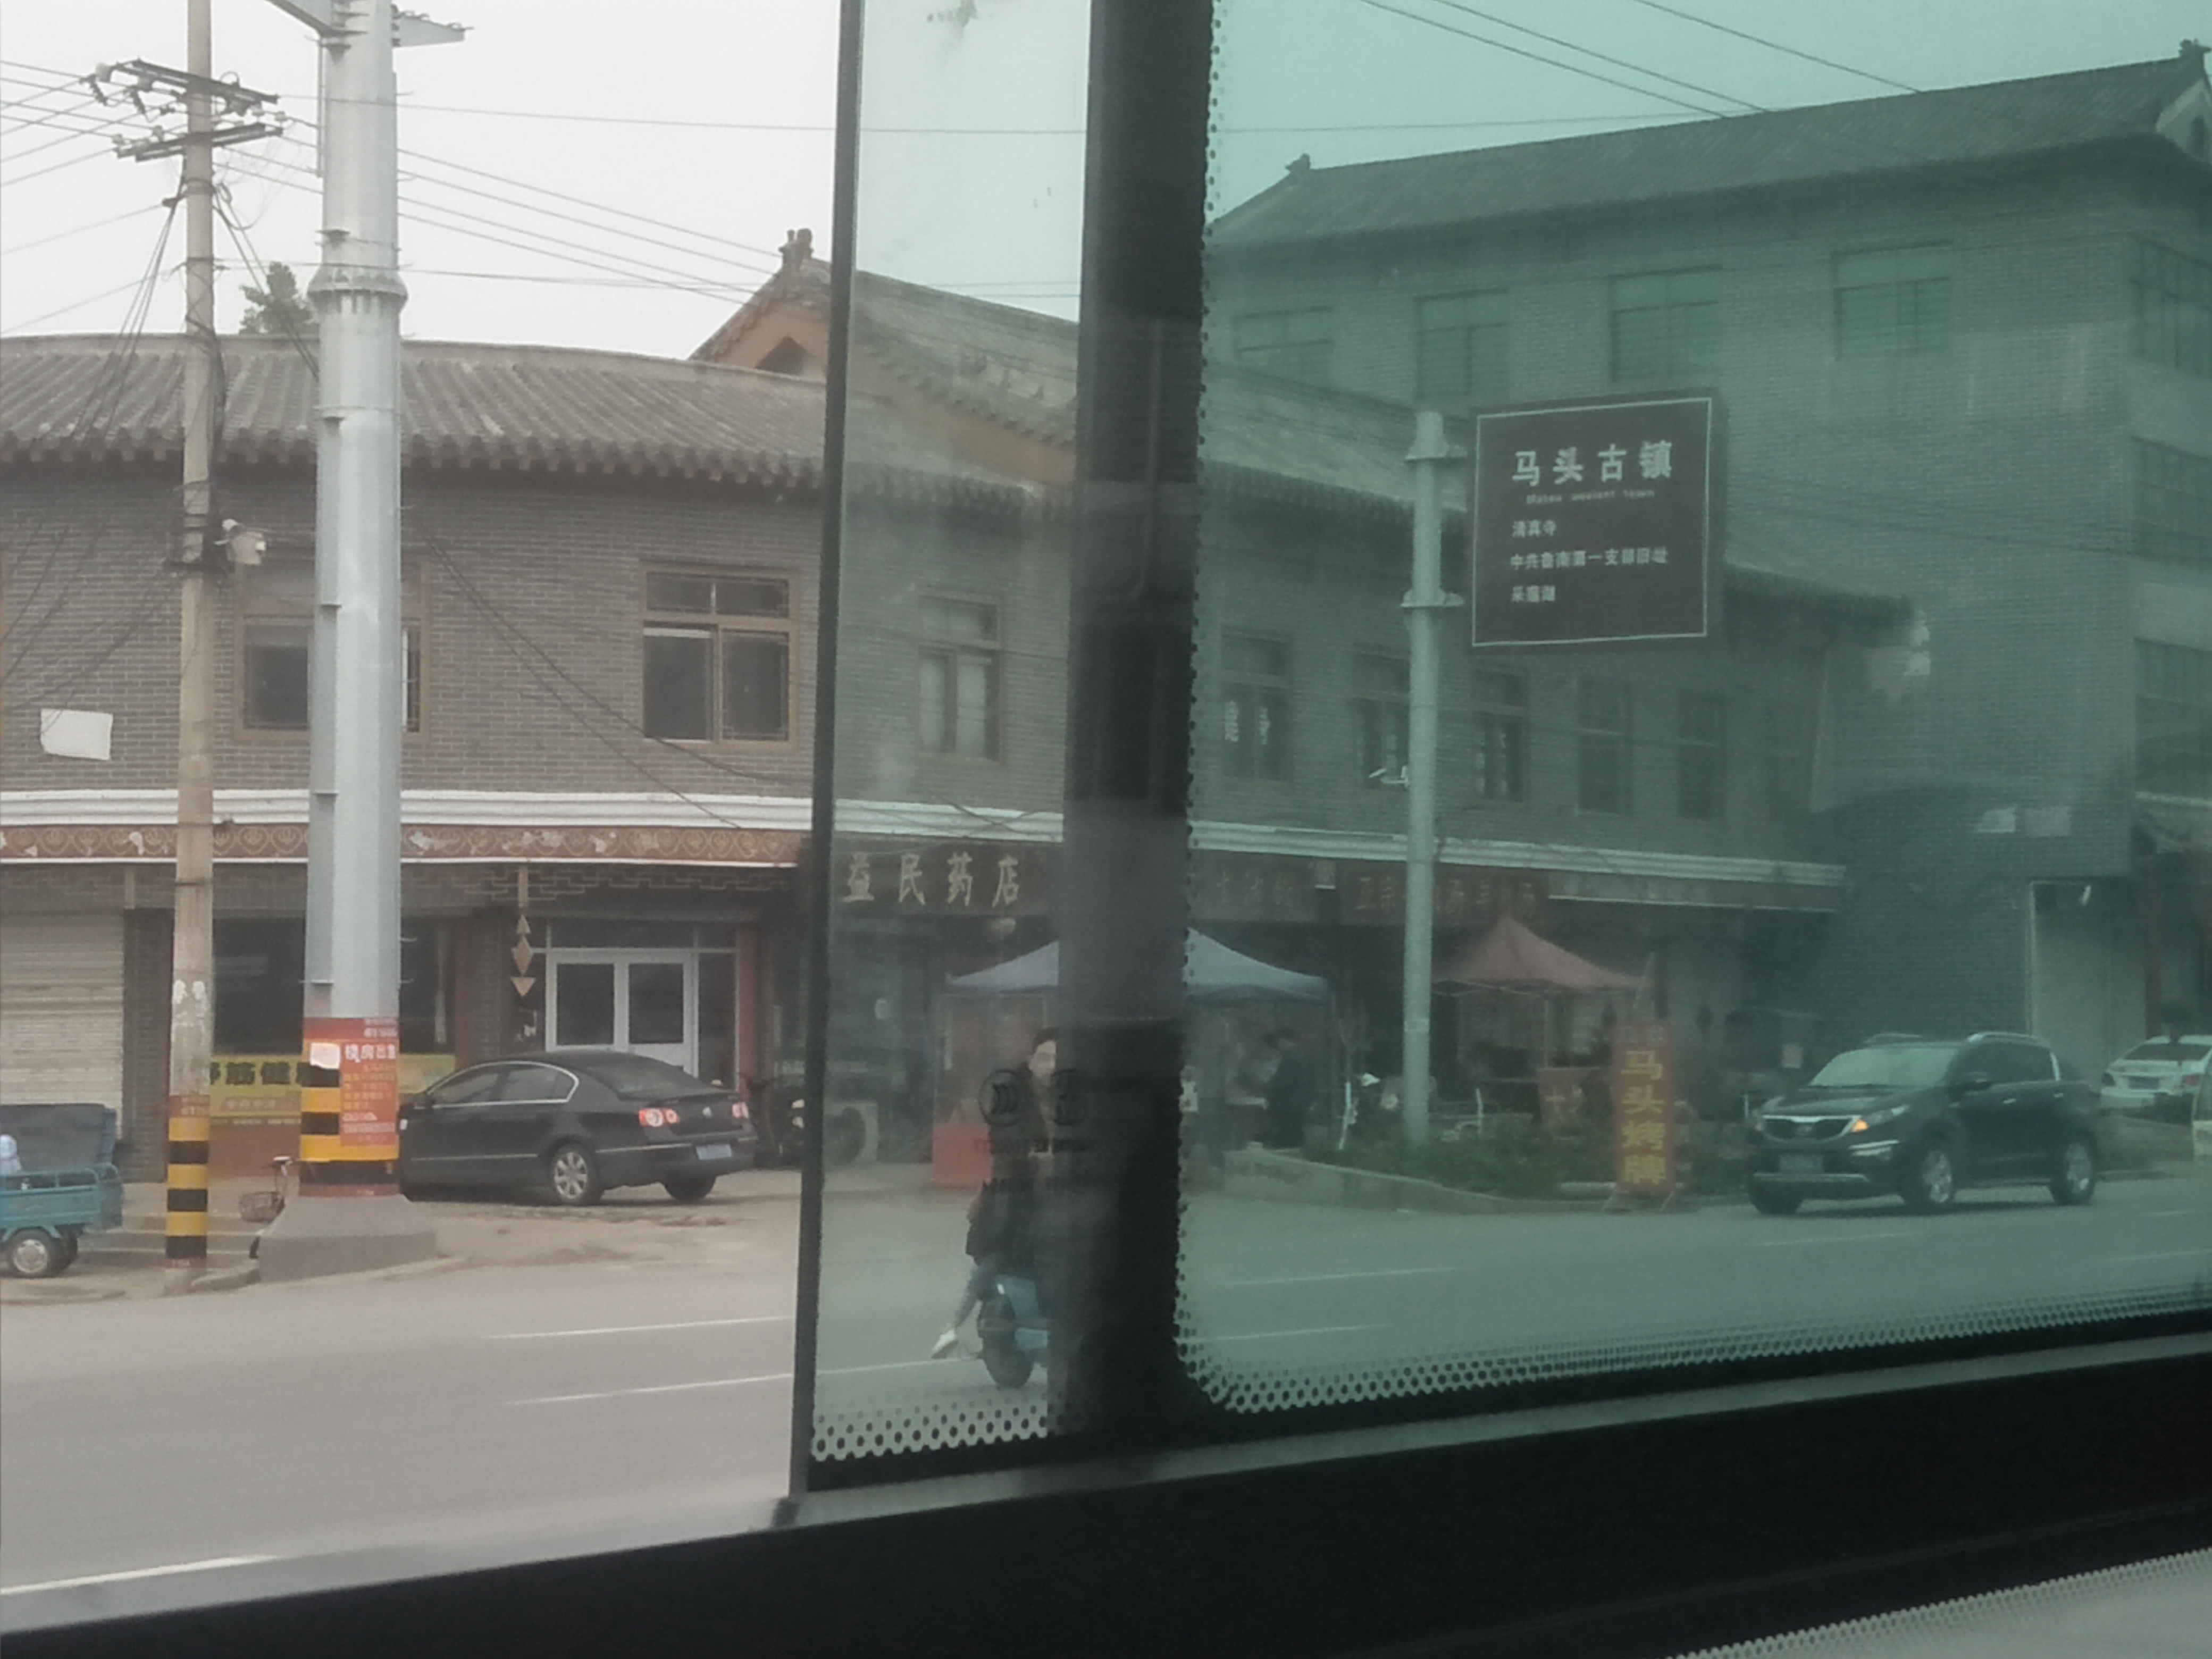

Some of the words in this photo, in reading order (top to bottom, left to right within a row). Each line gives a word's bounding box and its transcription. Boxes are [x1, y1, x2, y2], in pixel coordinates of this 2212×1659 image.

[1512, 439, 1672, 487] 马头古镇
[843, 852, 1019, 908] 益民药店
